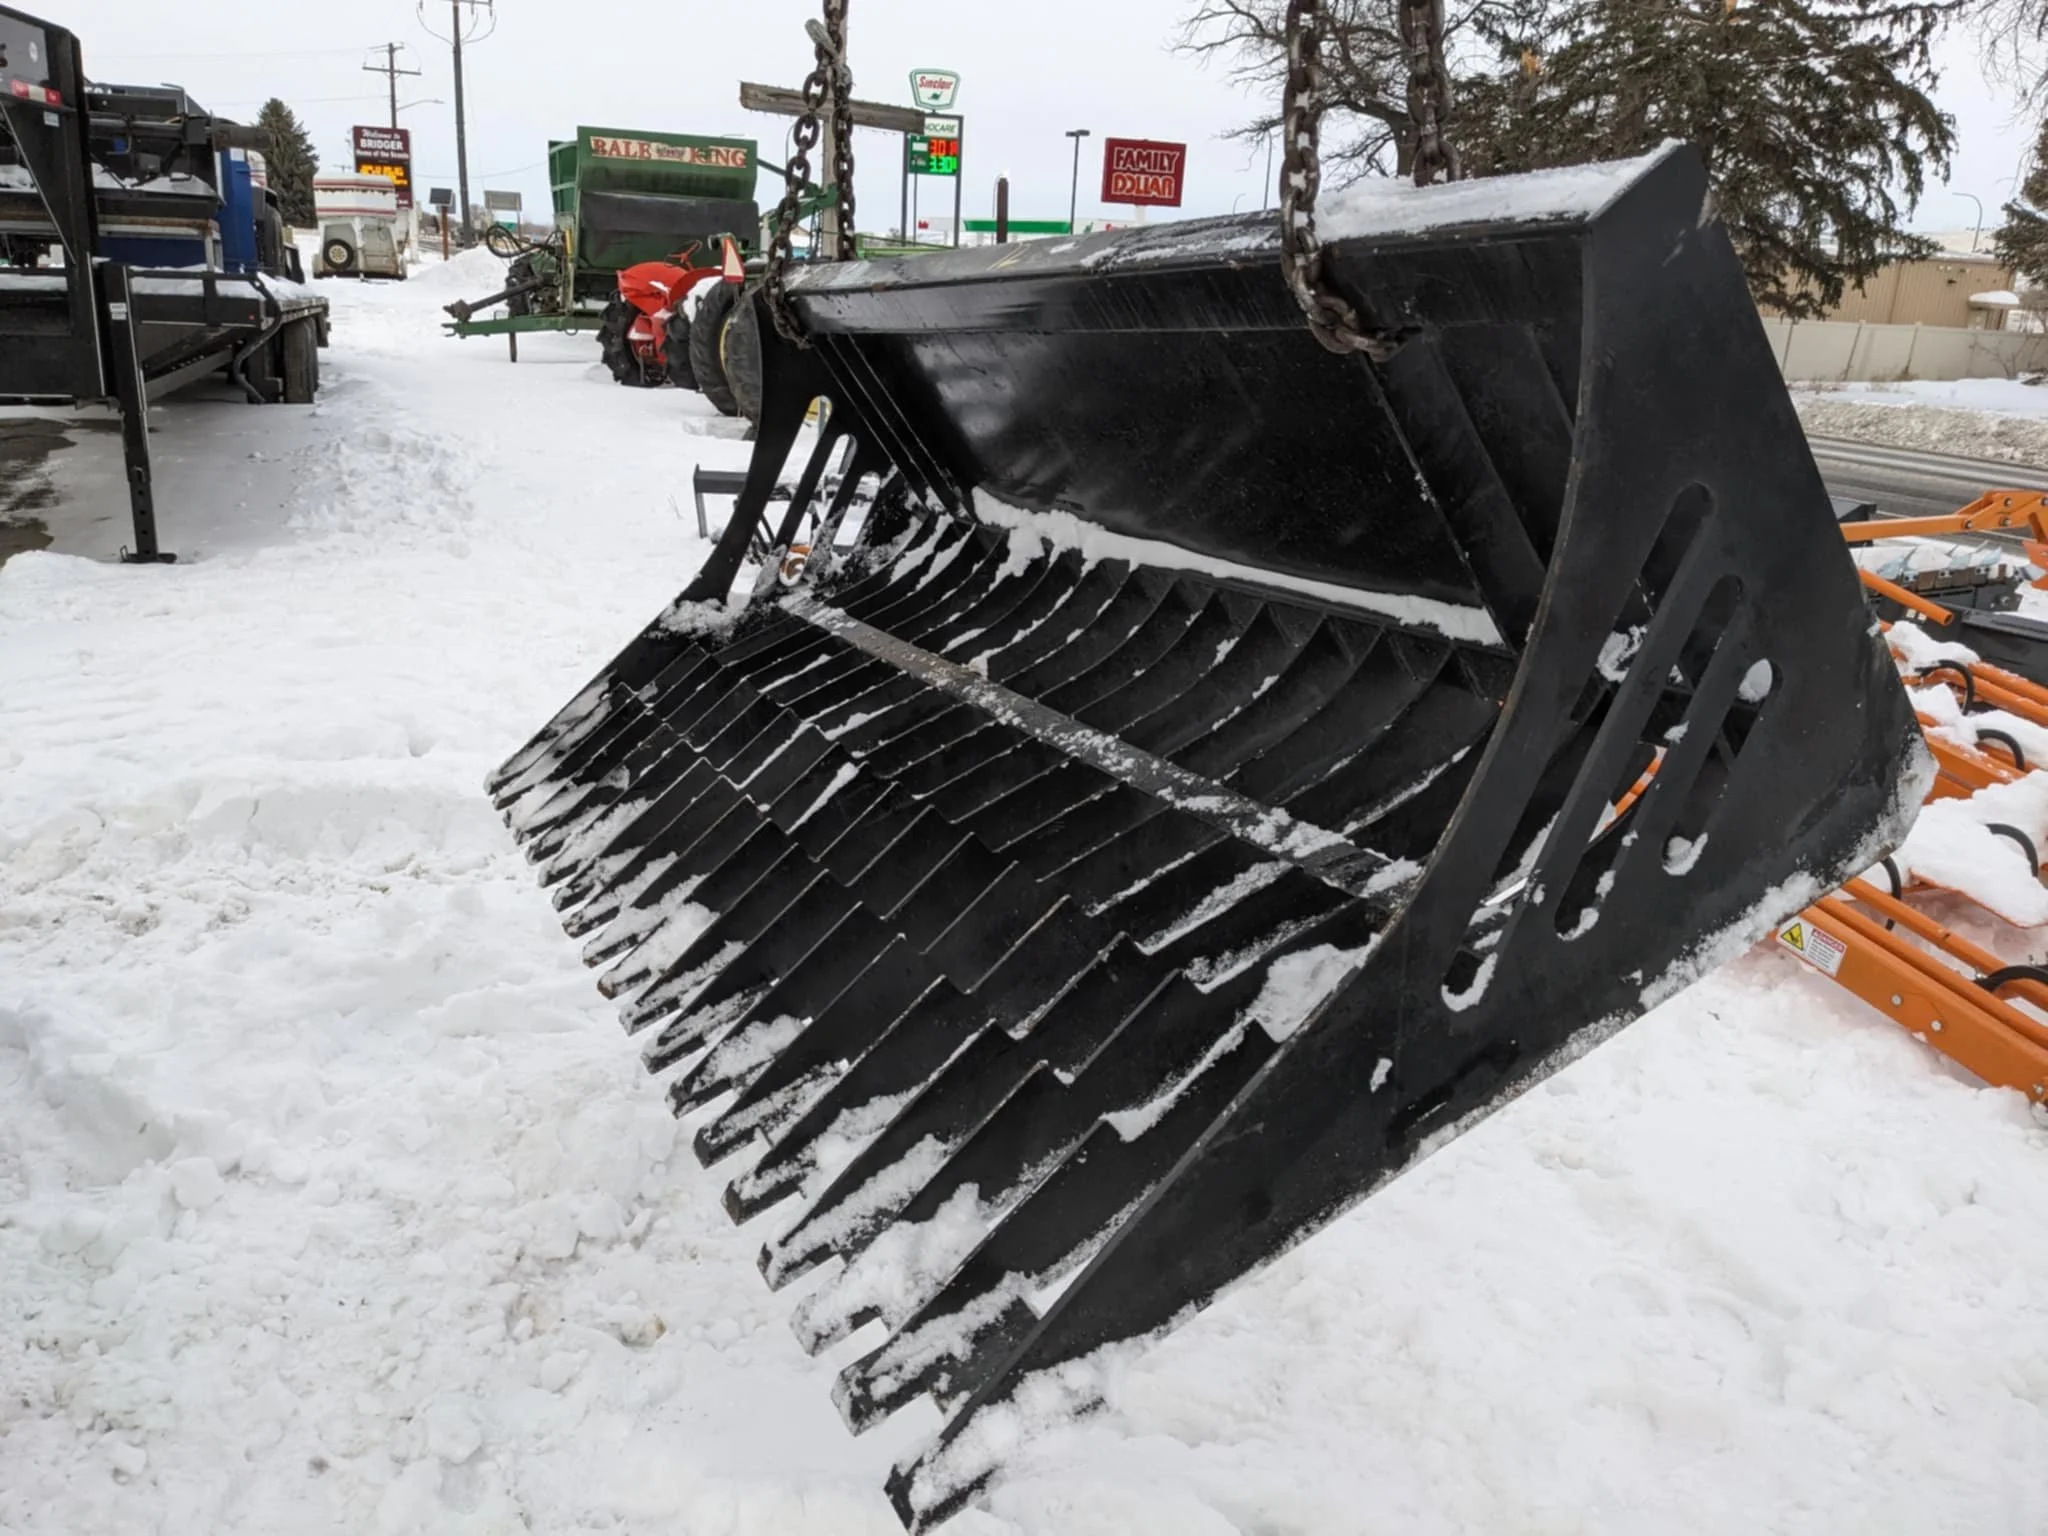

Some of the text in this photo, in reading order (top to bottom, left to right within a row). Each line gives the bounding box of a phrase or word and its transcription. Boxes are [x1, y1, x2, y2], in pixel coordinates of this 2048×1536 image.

[360, 138, 403, 151] BRIDGER
[592, 138, 652, 160] BALE
[1113, 146, 1180, 173] FAMILY
[1111, 171, 1175, 199] DOLLAR
